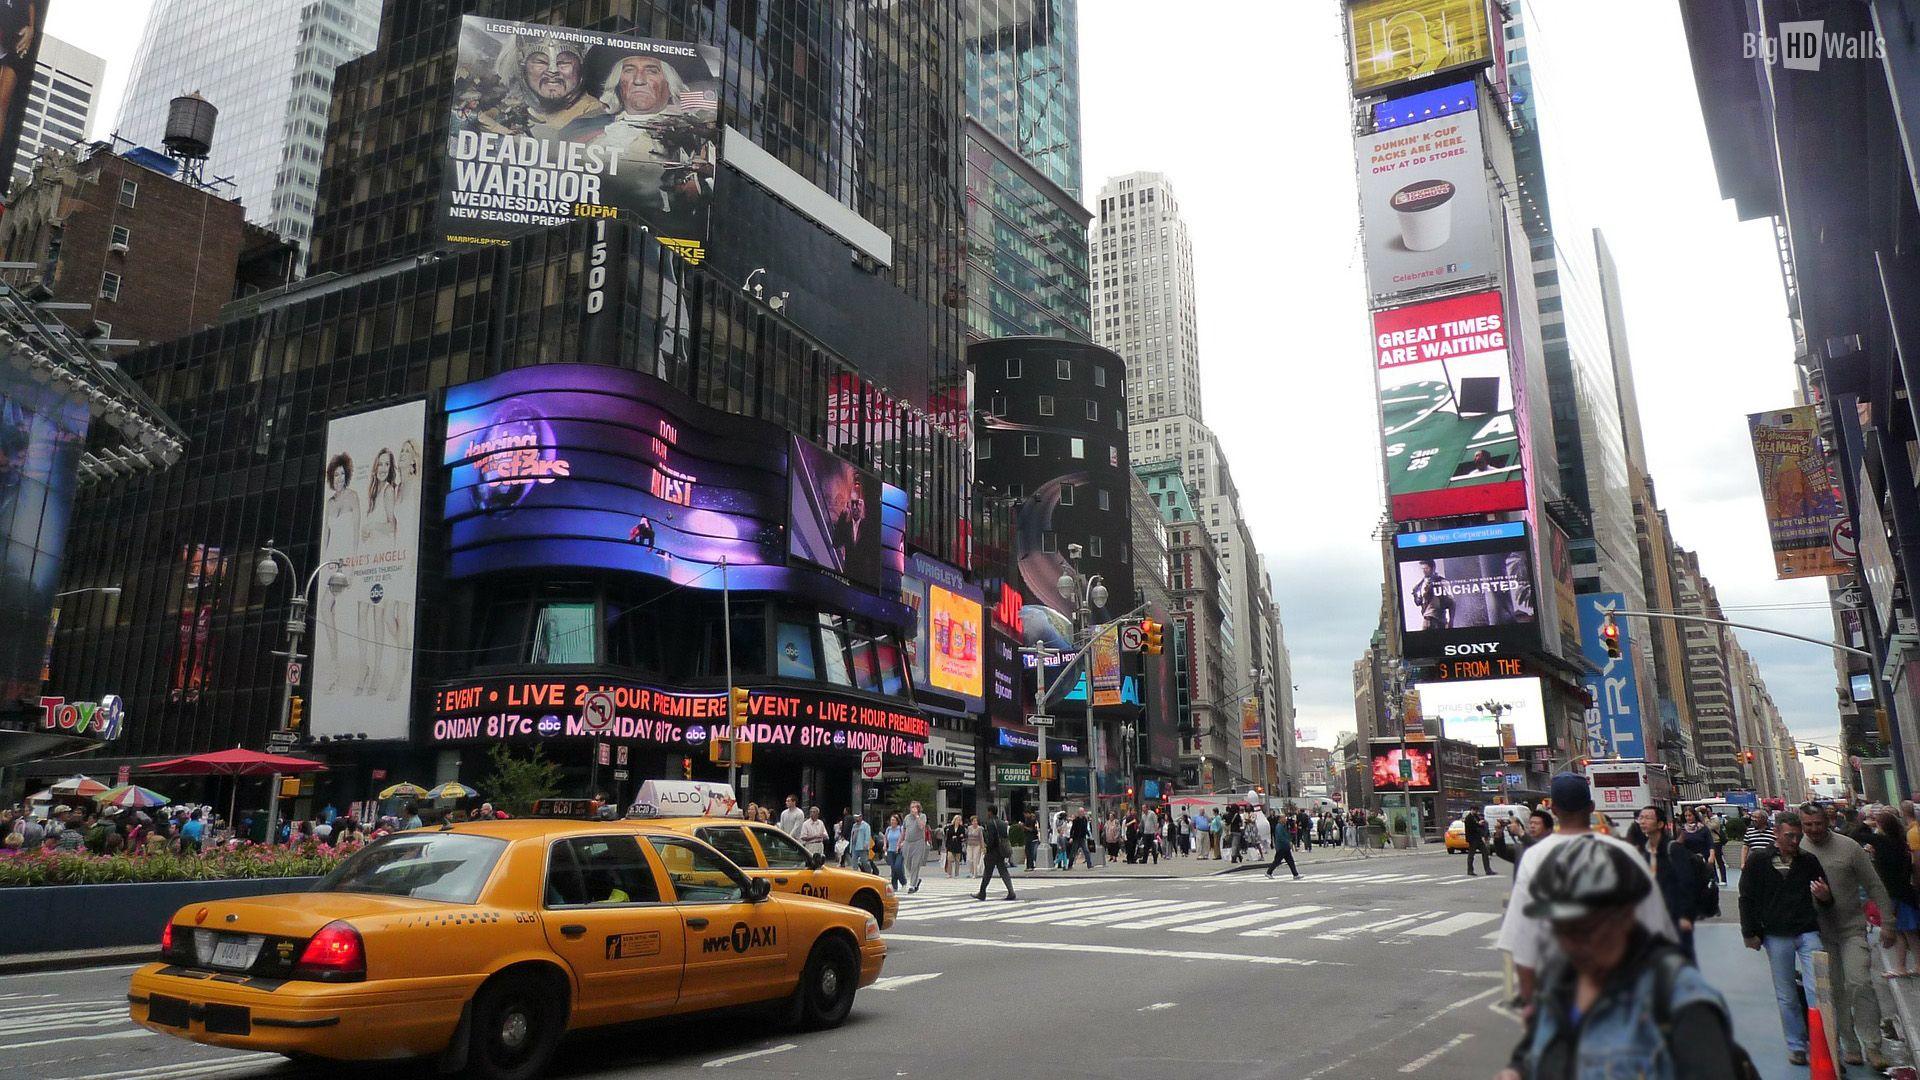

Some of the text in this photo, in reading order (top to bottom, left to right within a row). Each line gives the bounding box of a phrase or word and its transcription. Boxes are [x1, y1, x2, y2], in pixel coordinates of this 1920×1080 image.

[487, 23, 697, 57] LEGENDARY WARRIORS. MODERN SCIENCE.
[456, 130, 624, 176] DEADLIEST
[1371, 136, 1466, 164] PACKS ARE HERE.
[1374, 135, 1419, 152] DUNKIN'
[1372, 163, 1396, 174] ONLY
[1413, 157, 1426, 165] DD
[1429, 147, 1468, 161] STORES.
[455, 161, 601, 204] WARRIOR
[449, 207, 479, 219] NEW
[481, 209, 529, 224] SEASON
[451, 191, 570, 216] WEDNESDAYS
[587, 220, 607, 314] 1500
[1393, 269, 1434, 283] Celebrate
[1378, 314, 1501, 349] GREAT TIMES
[1379, 332, 1505, 366] ARE WAITING
[373, 549, 407, 564] ANGELS
[916, 559, 963, 590] WRIGLEY'S
[1433, 580, 1519, 597] UNCHARTED
[1000, 582, 1023, 633] JVC
[1028, 652, 1061, 667] Crstal
[1444, 642, 1500, 656] SONY
[1454, 660, 1490, 678] FROM
[1497, 659, 1522, 675] THE
[445, 687, 483, 711] EVENT
[508, 684, 566, 706] LIVE
[575, 684, 590, 706] 2
[599, 685, 650, 711] OUR
[653, 692, 727, 719] PREMIERE
[745, 695, 801, 717] VENT
[819, 701, 848, 723] LIVE
[851, 706, 858, 724] 2
[860, 706, 887, 729] HOUR
[888, 713, 924, 737] PREMIERE
[434, 716, 482, 740] ONDAY
[538, 717, 561, 731] abc
[566, 715, 653, 740] MNDAY
[685, 728, 706, 741] abc
[847, 731, 889, 753] MONDAY
[660, 792, 701, 804] ALDO
[702, 922, 777, 954] NYC TAXI
